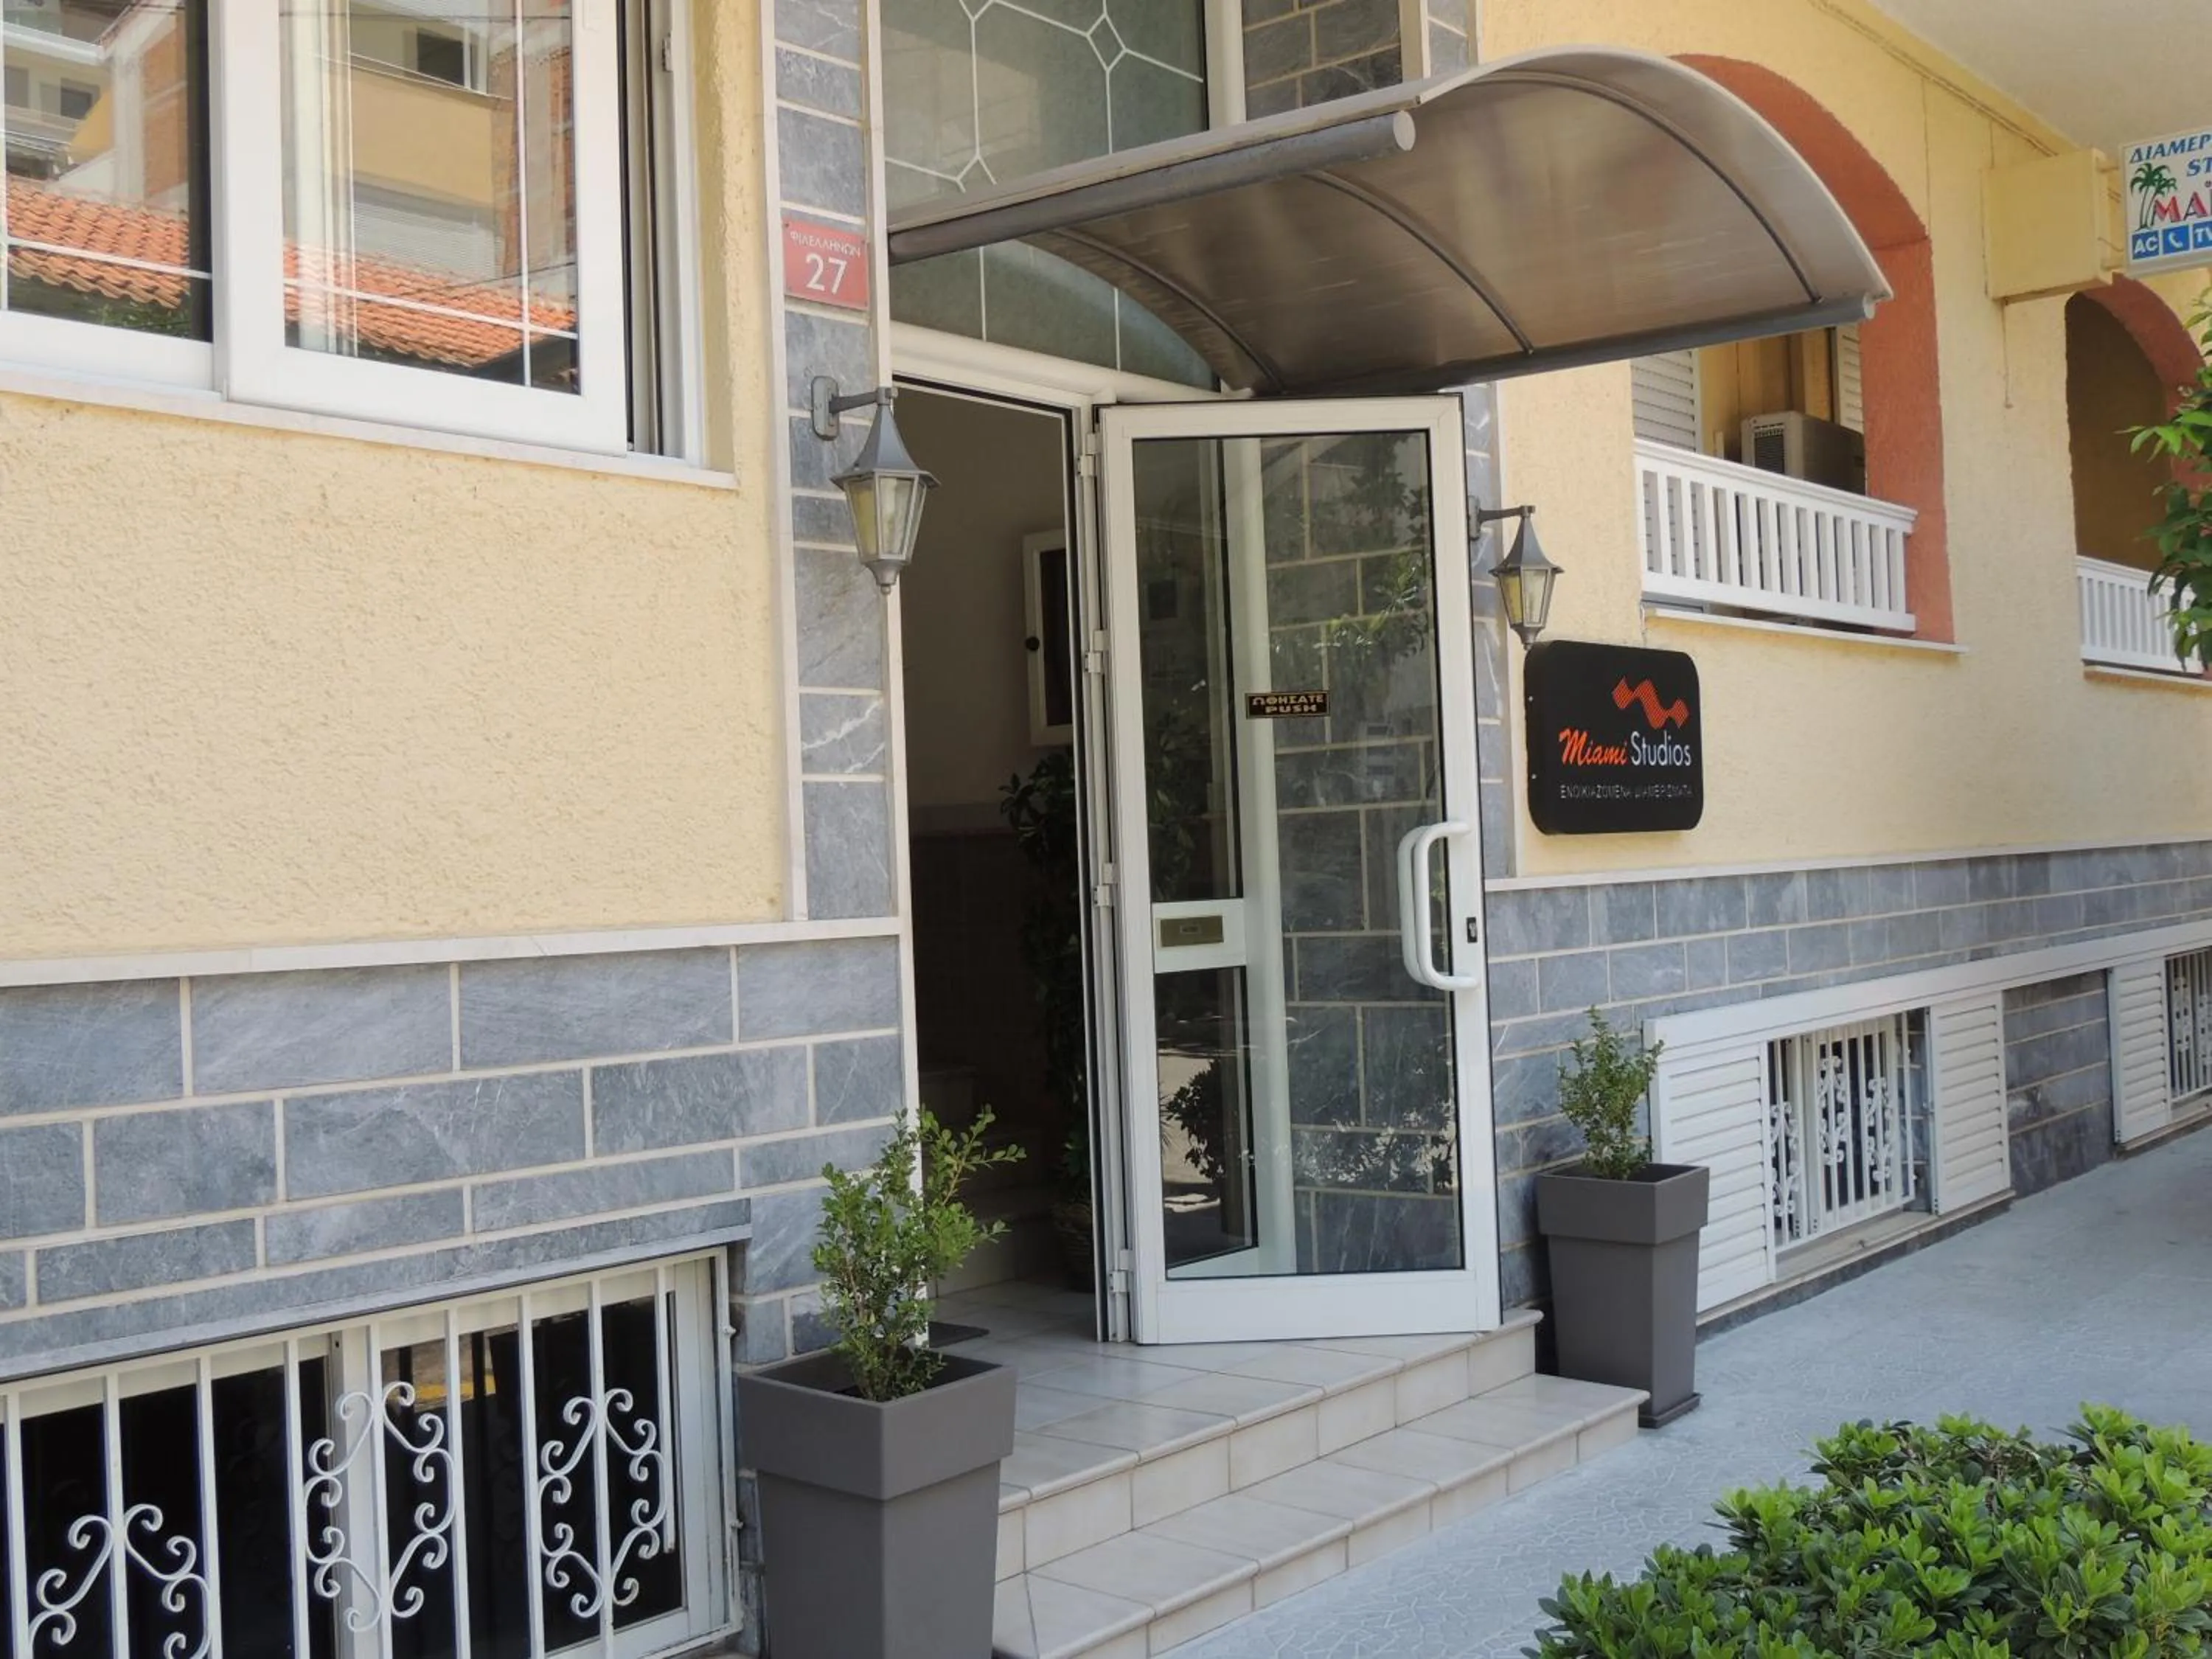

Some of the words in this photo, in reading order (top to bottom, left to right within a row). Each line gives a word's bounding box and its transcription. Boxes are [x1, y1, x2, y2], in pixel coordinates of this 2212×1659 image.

[2151, 188, 2212, 226] MA
[2135, 236, 2158, 254] AC
[806, 252, 847, 295] 27
[1265, 704, 1317, 714] PUSH
[1559, 727, 1627, 766] Miami
[1630, 731, 1691, 766] Studios
